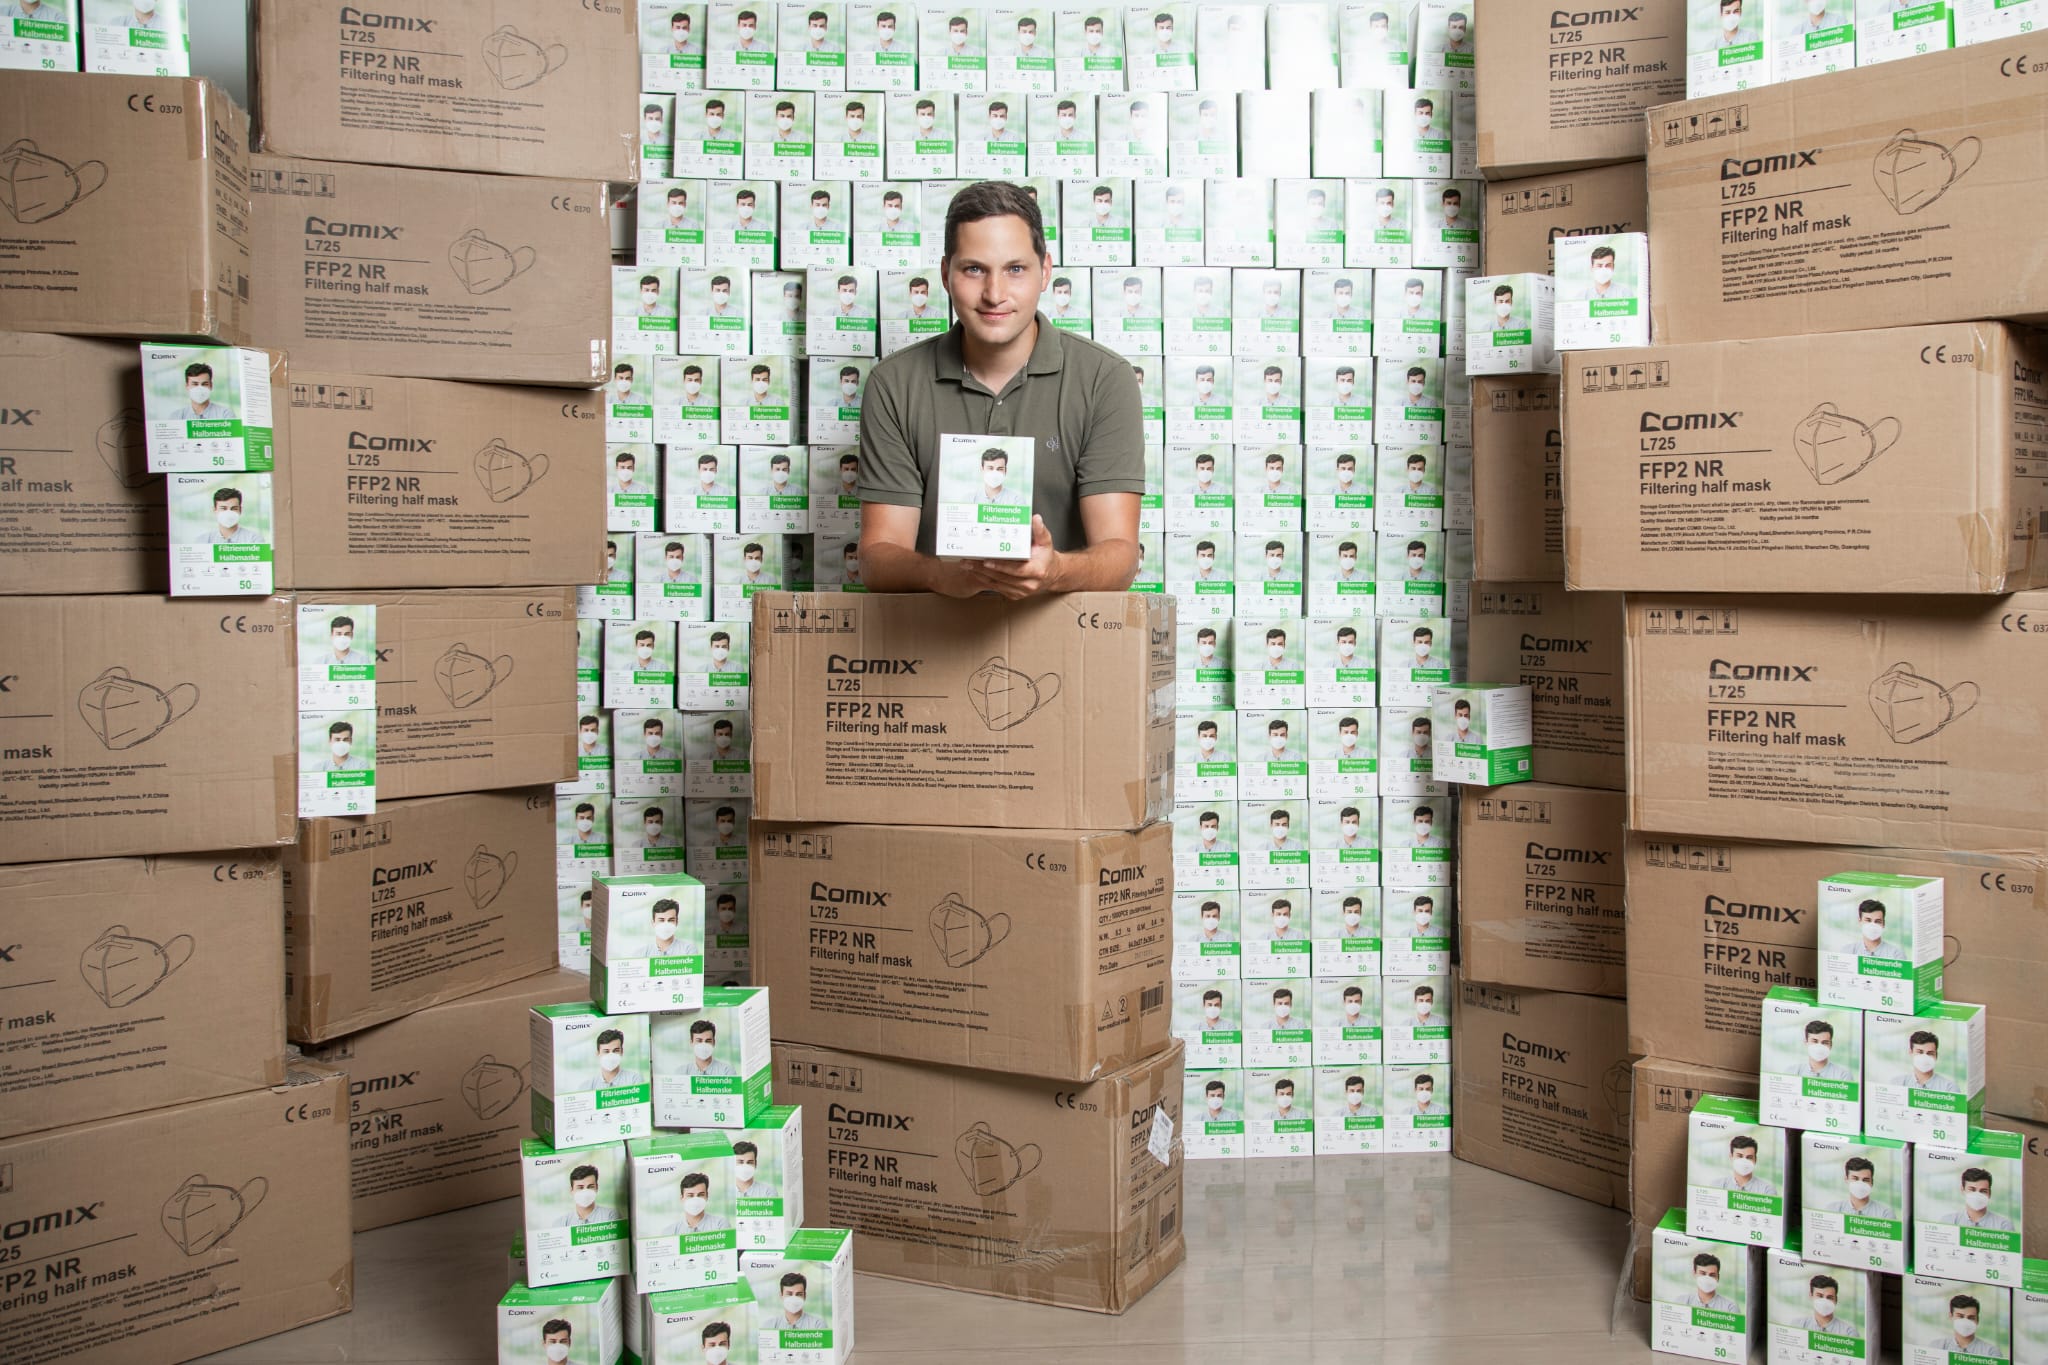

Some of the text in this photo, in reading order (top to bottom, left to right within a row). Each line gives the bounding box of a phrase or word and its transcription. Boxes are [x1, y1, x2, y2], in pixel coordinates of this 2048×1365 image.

[19, 19, 65, 31] Filtrierende
[340, 7, 432, 33] Comix
[1550, 7, 1639, 29] Comix
[20, 28, 65, 41] Halbmaske
[1916, 43, 1927, 54] 50
[42, 59, 55, 68] 50
[340, 50, 420, 71] FFP2 NR
[1549, 48, 1626, 68] FFP2 NR
[1550, 60, 1668, 81] Filtering mask
[2033, 62, 2048, 73] 037
[340, 67, 463, 88] Filtering mask
[159, 105, 182, 114] 0370
[1720, 149, 1816, 181] Comix
[1721, 182, 1756, 200] L725
[1721, 200, 1804, 229] FFP2 NR
[305, 216, 399, 240] Comix
[1722, 227, 1777, 244] Filtering
[1782, 220, 1808, 236] half
[1812, 214, 1851, 232] mask
[305, 260, 386, 279] FFP2 NR
[305, 278, 429, 295] Filtering mask
[1951, 354, 1974, 363] 0370
[1640, 411, 1738, 432] Comix
[348, 431, 432, 453] Comix
[1641, 437, 1676, 451] L725
[213, 457, 224, 466] 50
[348, 454, 380, 466] L725
[1640, 460, 1724, 479] FFP2 NR
[348, 475, 420, 491] FFP2 NR
[1640, 479, 1771, 496] Filtering half mask
[348, 493, 458, 507] Filtering half mask
[982, 506, 1022, 515] Filtrierende
[1000, 542, 1011, 551] 50
[252, 625, 274, 633] 0370
[1103, 622, 1122, 630] 0370
[2033, 624, 2048, 633] 037
[1520, 633, 1589, 653] Comix
[827, 654, 918, 674] Comix
[1520, 655, 1545, 666] L725
[1709, 659, 1812, 681] Comix
[828, 679, 860, 691] L725
[1558, 677, 1578, 692] NR
[385, 704, 417, 716] mask
[826, 702, 904, 718] FFP2 NR
[1708, 709, 1796, 729] FFP2 NR
[827, 720, 947, 736] Filtering half mask
[1709, 729, 1846, 747] Filtering mask
[4, 745, 52, 759] mask
[1526, 842, 1608, 865] Comix
[243, 869, 264, 879] 0370
[372, 860, 434, 886] Comix
[1049, 863, 1067, 872] 0370
[1427, 873, 1437, 883] 50
[810, 881, 887, 907] Comix
[1099, 891, 1118, 906] FFP2
[1120, 888, 1131, 901] NR
[1525, 884, 1595, 903] FFP2 NR
[2011, 884, 2033, 894] 0370
[371, 901, 425, 928] FFP2 NR
[810, 905, 838, 919] L725
[1526, 900, 1574, 917] Filtering
[1704, 895, 1801, 924] Comix
[430, 911, 453, 926] mask
[810, 928, 875, 949] FFP2 NR
[654, 957, 693, 965] Filtrierende
[810, 946, 912, 967] Filtering half mask
[1704, 943, 1787, 969] FFP2 NR
[1861, 956, 1903, 968] Filtrierende
[655, 967, 692, 975] Halbmaske
[1705, 962, 1760, 984] Filtering
[1864, 968, 1902, 978] Halbmaske
[672, 994, 684, 1003] 50
[1881, 996, 1893, 1006] 50
[8, 1010, 56, 1030] mask
[1502, 1032, 1570, 1067] Comix
[1502, 1072, 1557, 1099] FFP2 NR
[312, 1107, 331, 1119] 0370
[1079, 1102, 1097, 1112] 0370
[376, 1114, 403, 1131] NR
[828, 1103, 910, 1131] Comix
[828, 1149, 898, 1173] FFP2 NR
[829, 1167, 937, 1193] Filtering mask
[0, 1203, 98, 1241] omix
[1849, 1217, 1891, 1228] Filtrierende
[685, 1232, 726, 1242] Filtrierende
[1850, 1227, 1890, 1238] Halbmaske
[685, 1240, 727, 1253] Halbmaske
[597, 1261, 610, 1271] 50
[1869, 1256, 1882, 1266] 50
[46, 1257, 81, 1282] NR
[705, 1270, 717, 1280] 50
[1986, 1269, 1999, 1279] 50
[54, 1264, 136, 1297] half mask
[1715, 1347, 1726, 1357] 50
